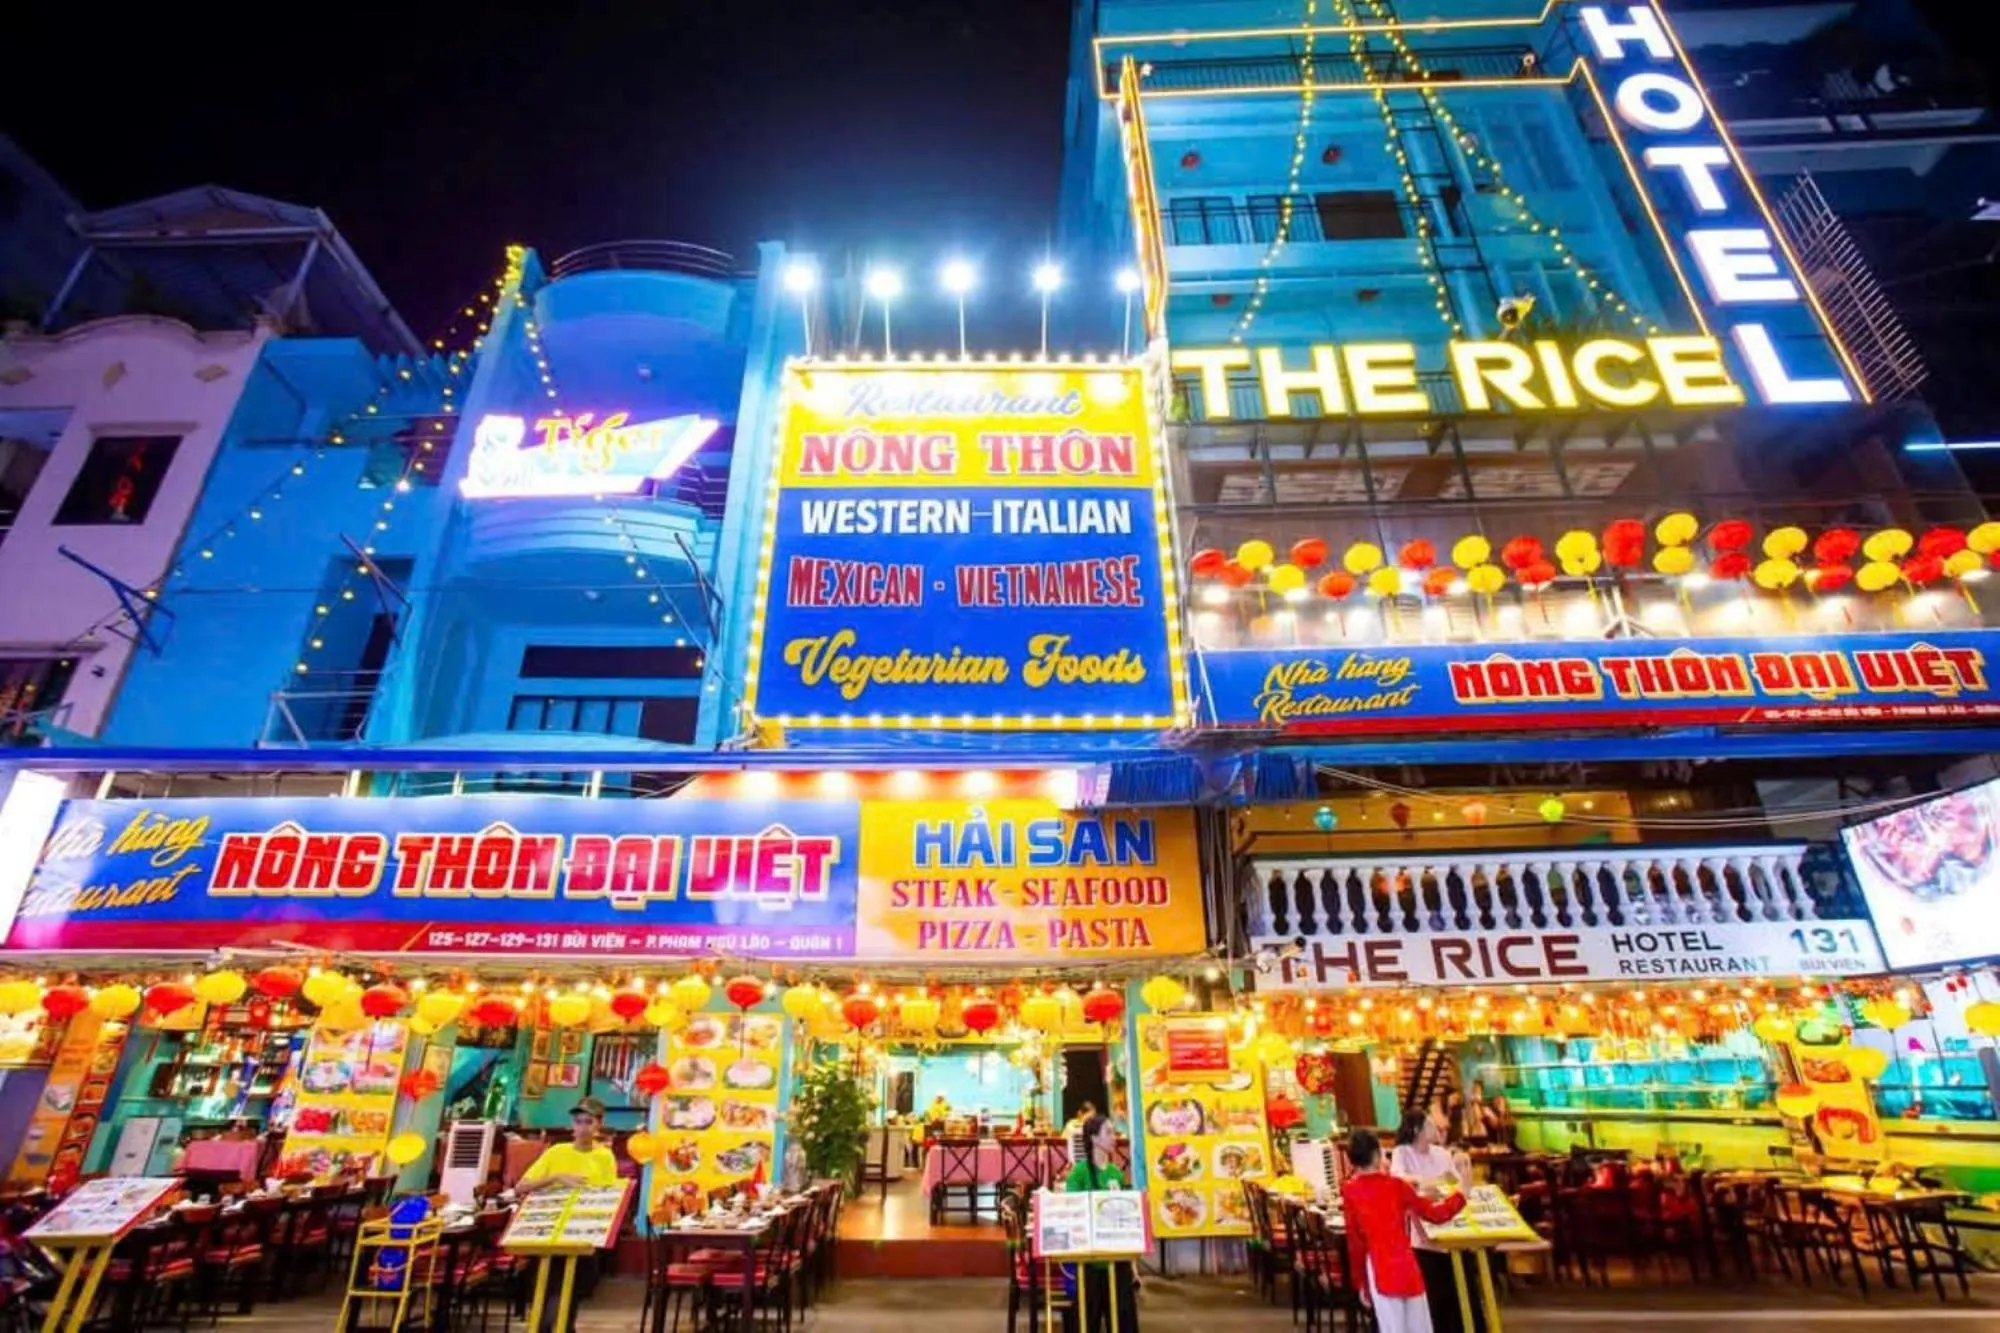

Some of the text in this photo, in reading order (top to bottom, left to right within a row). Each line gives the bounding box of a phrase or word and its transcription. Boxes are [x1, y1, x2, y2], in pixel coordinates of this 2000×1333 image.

[1580, 5, 1852, 404] HOTEL
[844, 380, 1081, 416] Restaurant
[1170, 337, 1744, 418] THE RICE
[536, 412, 663, 472] Tiger
[800, 428, 1137, 476] NÔNG THÔN
[787, 555, 1143, 607] MEXICAN VIETNAMESE
[784, 629, 1147, 700] Vegetarian Foods
[1264, 653, 1416, 694] Nhà hàng
[1447, 653, 1603, 704] NÔNG
[1599, 647, 1755, 699] THÔN
[1253, 684, 1422, 724] Restaurant
[107, 810, 210, 866] hàng
[208, 820, 388, 897] NÔNG
[392, 820, 564, 898] THÔN
[564, 834, 681, 910] ĐẠI
[891, 876, 1170, 908] STEAK SEAFOOD
[918, 917, 1152, 949] PIZZA PASTA
[1611, 930, 1724, 953] HOTEL
[1789, 927, 1861, 954] 131
[1262, 935, 1589, 983] THE RICE
[1619, 956, 1770, 975] RESTAURANT
